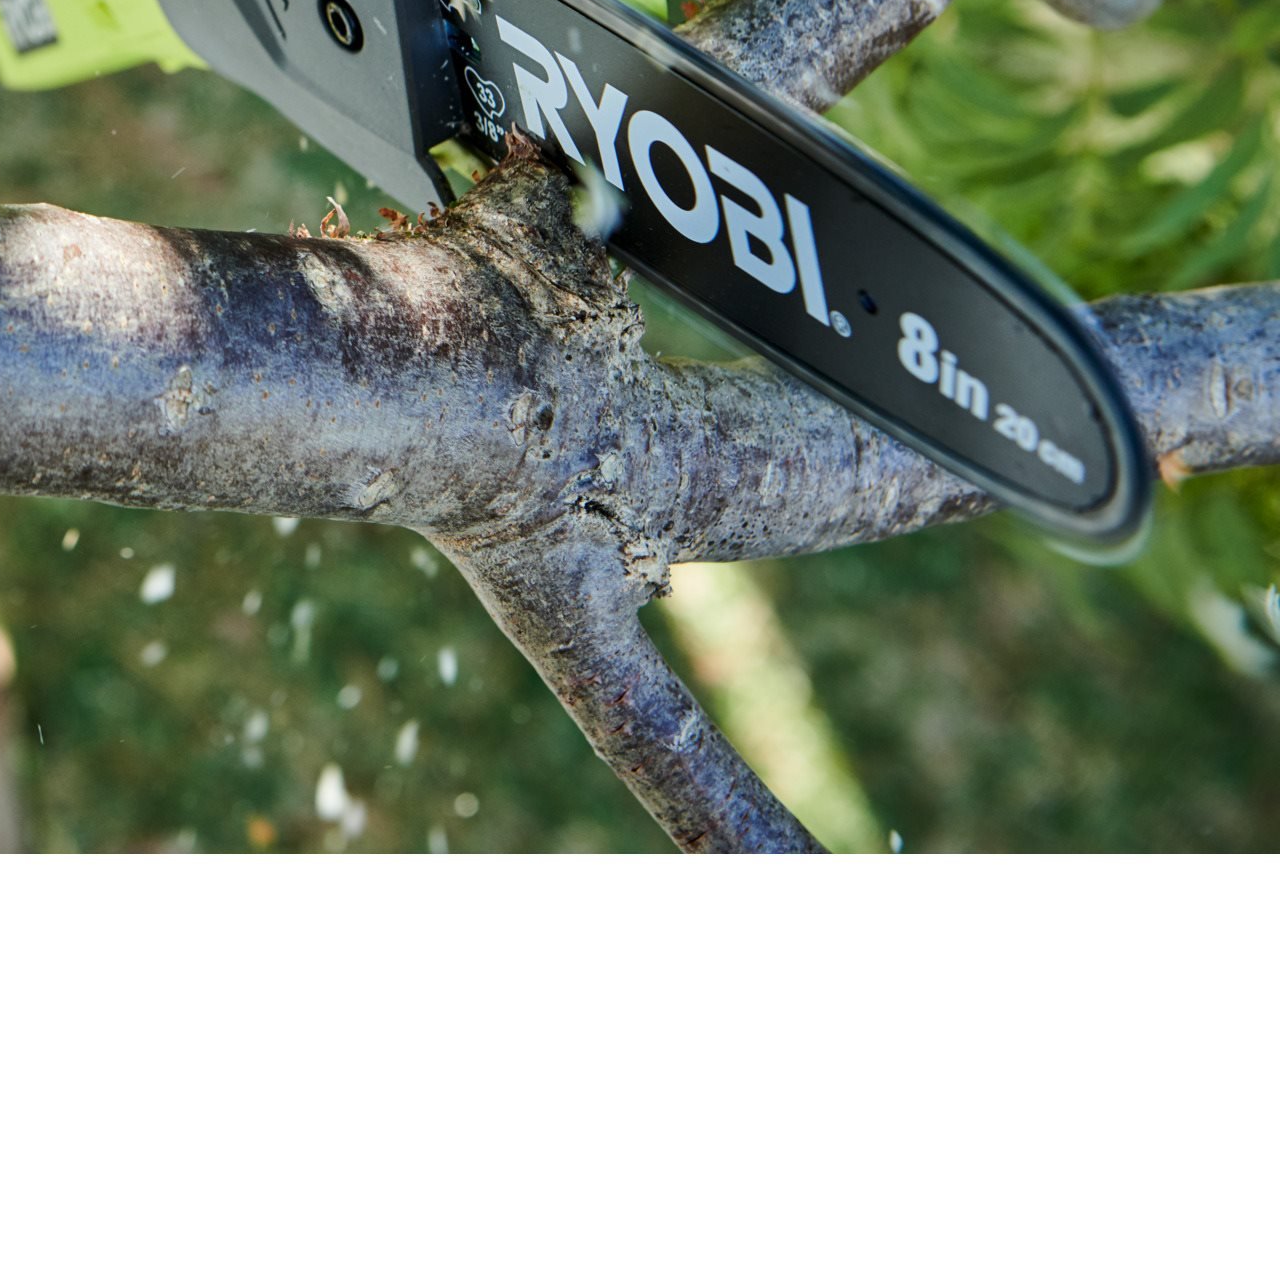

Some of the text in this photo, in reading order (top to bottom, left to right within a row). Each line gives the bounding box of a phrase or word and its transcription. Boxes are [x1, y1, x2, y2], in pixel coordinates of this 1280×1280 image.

[476, 81, 496, 109] 33
[495, 14, 831, 328] RYOBI
[993, 403, 1039, 452] 20
